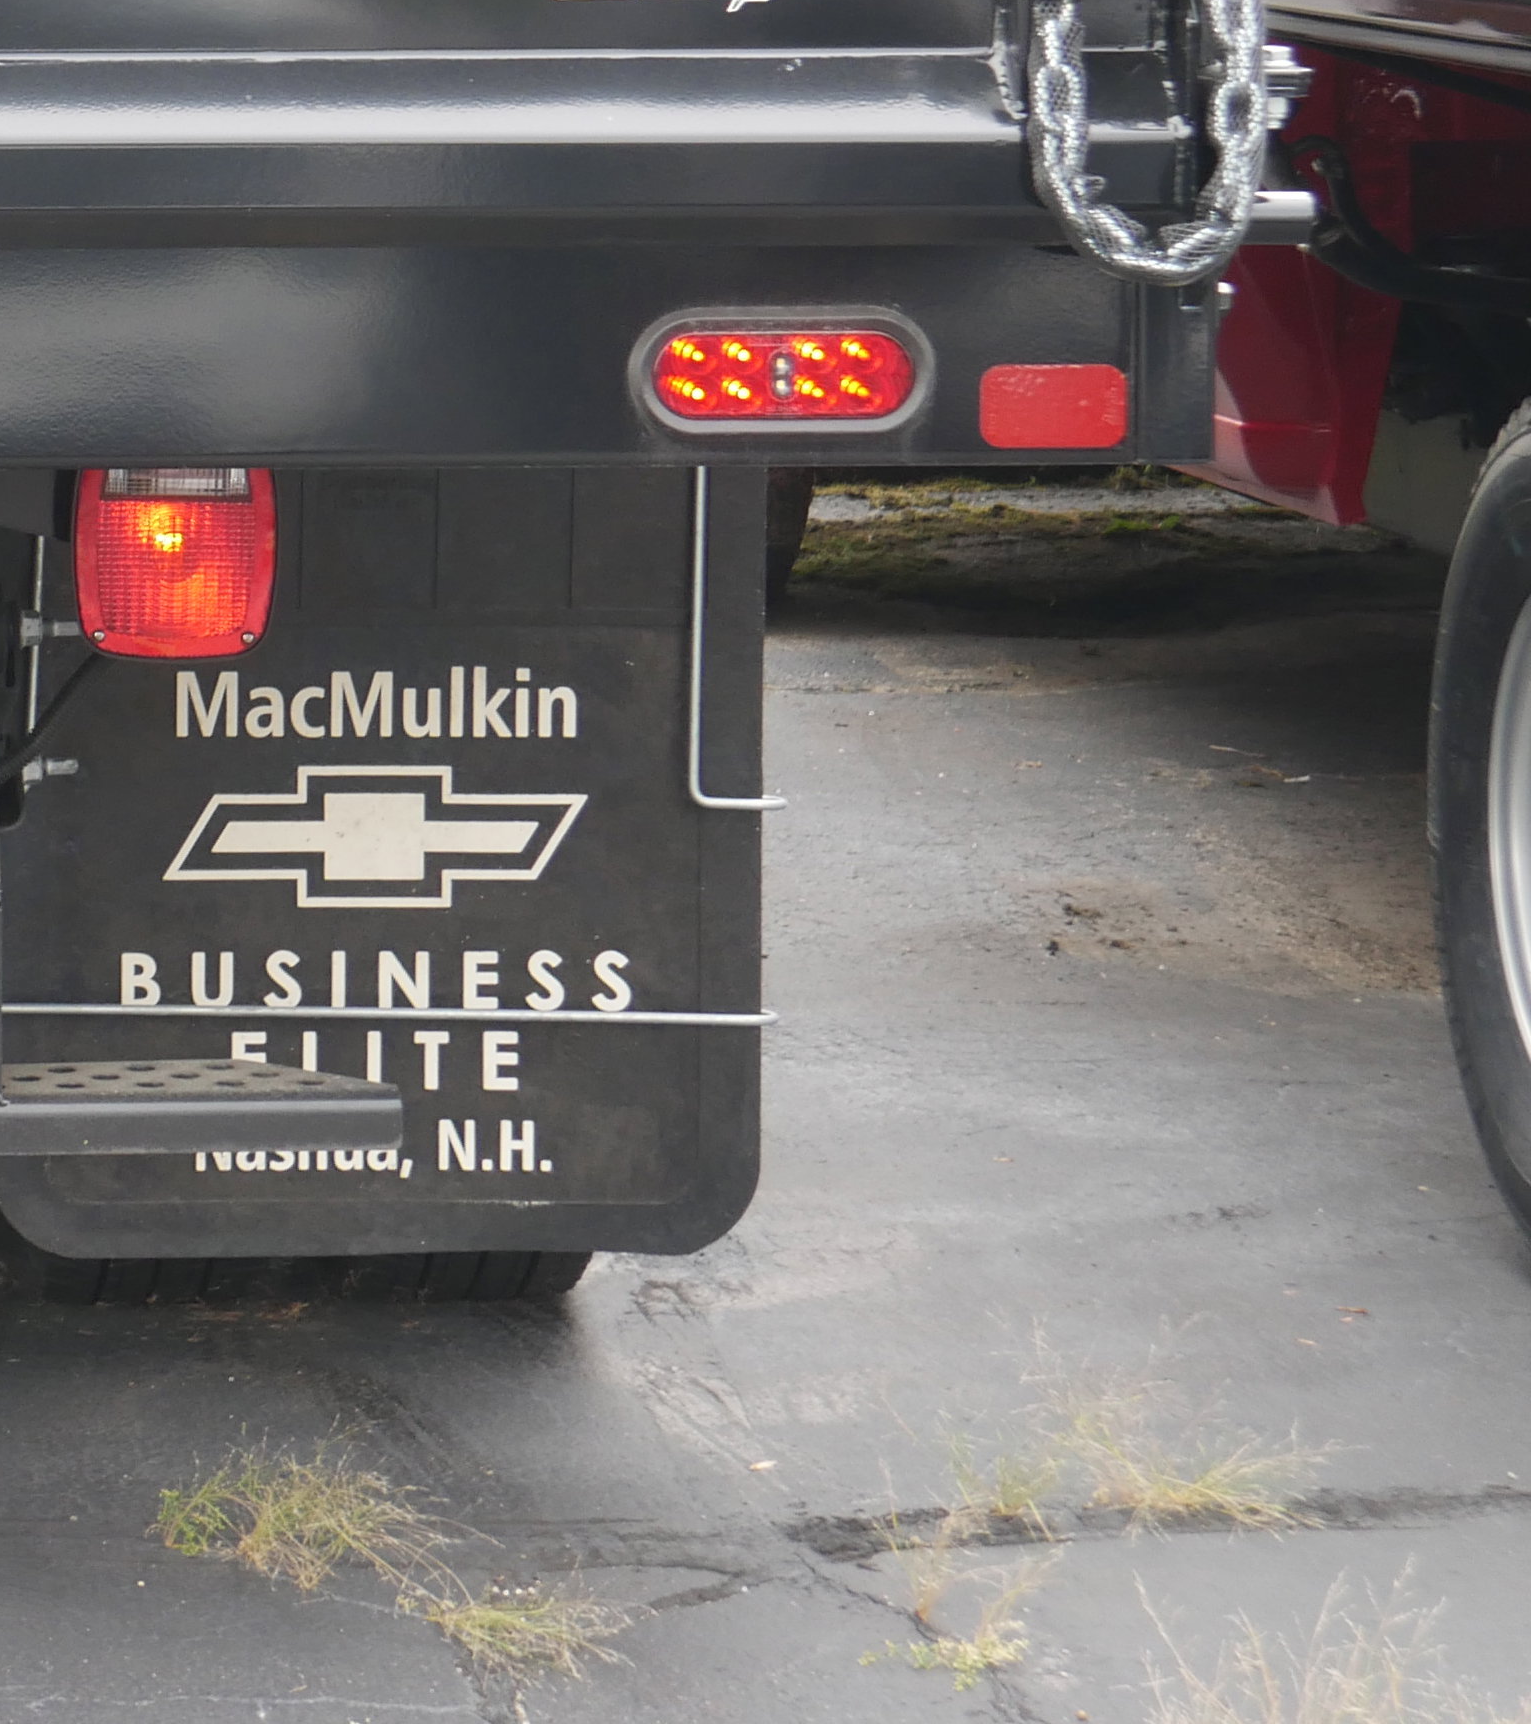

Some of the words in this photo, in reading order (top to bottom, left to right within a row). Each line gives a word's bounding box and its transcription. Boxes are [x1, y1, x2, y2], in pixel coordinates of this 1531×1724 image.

[175, 666, 578, 739] MacMulkin
[120, 949, 632, 1012] BUSINESS
[438, 1119, 553, 1172] N.H.
